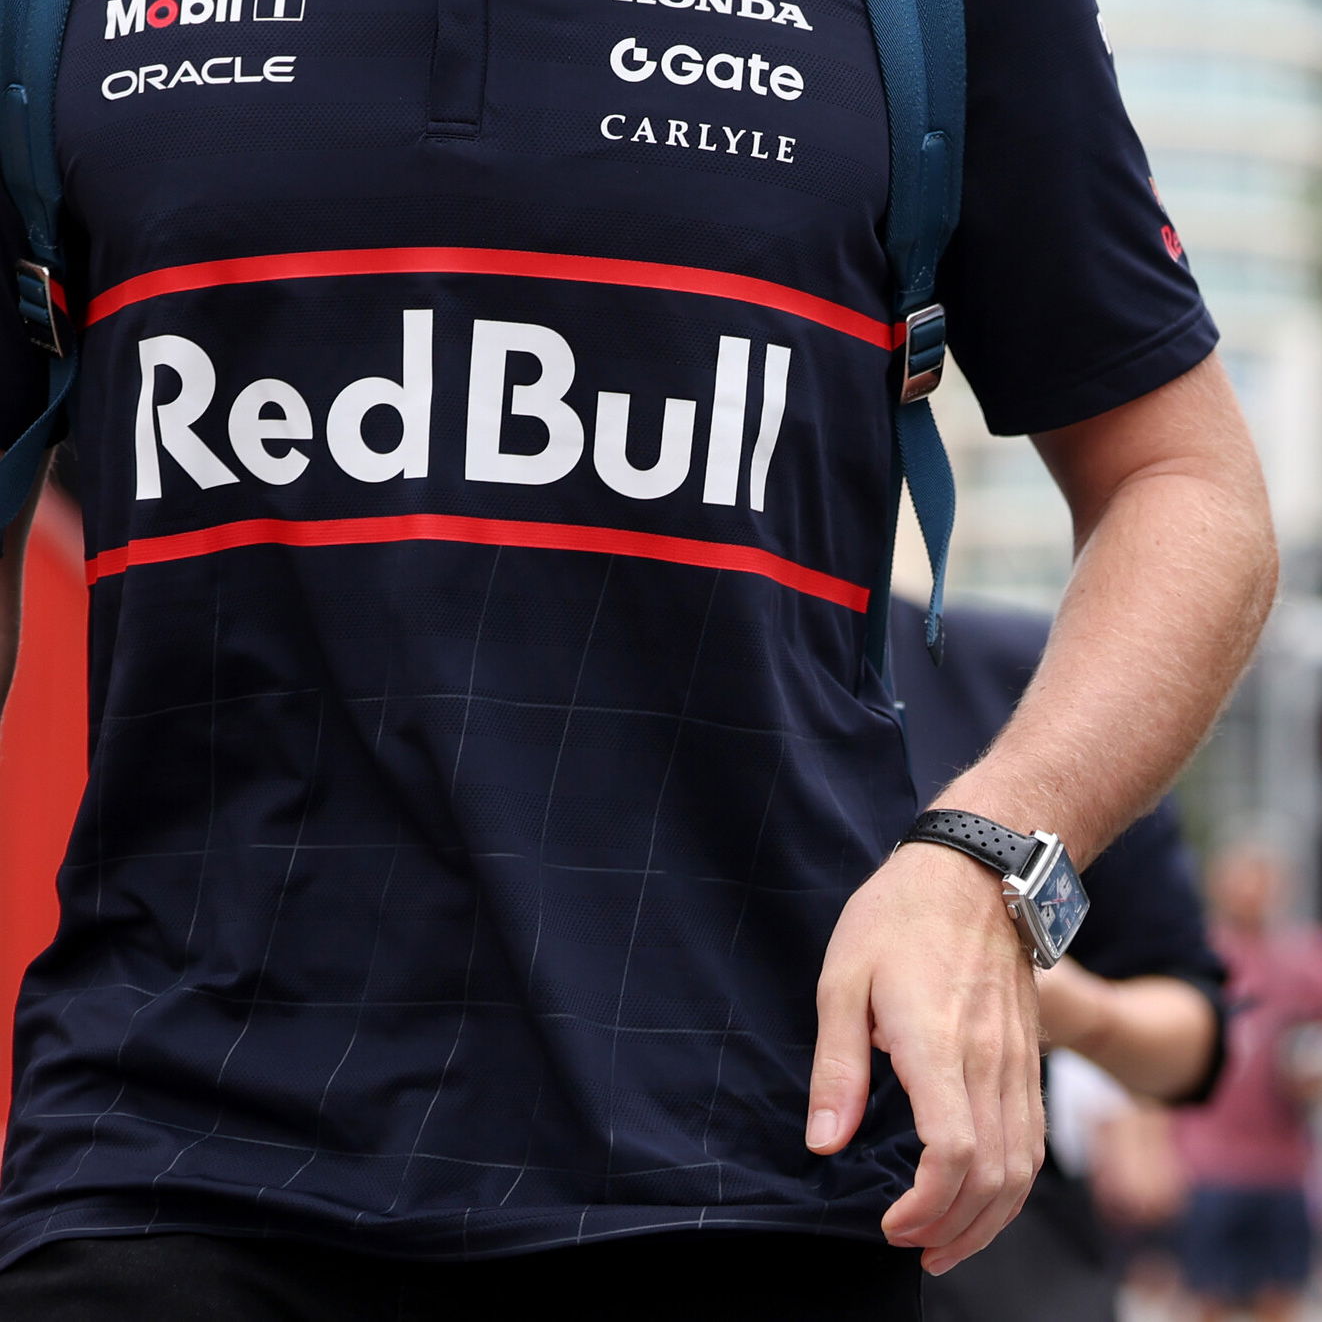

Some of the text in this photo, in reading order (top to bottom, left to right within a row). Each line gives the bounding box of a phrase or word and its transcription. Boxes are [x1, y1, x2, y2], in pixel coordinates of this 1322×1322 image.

[101, 56, 296, 100] ORACLE
[661, 44, 804, 101] Gate
[600, 114, 797, 164] CARLYLE
[135, 309, 792, 512] Red Bull
